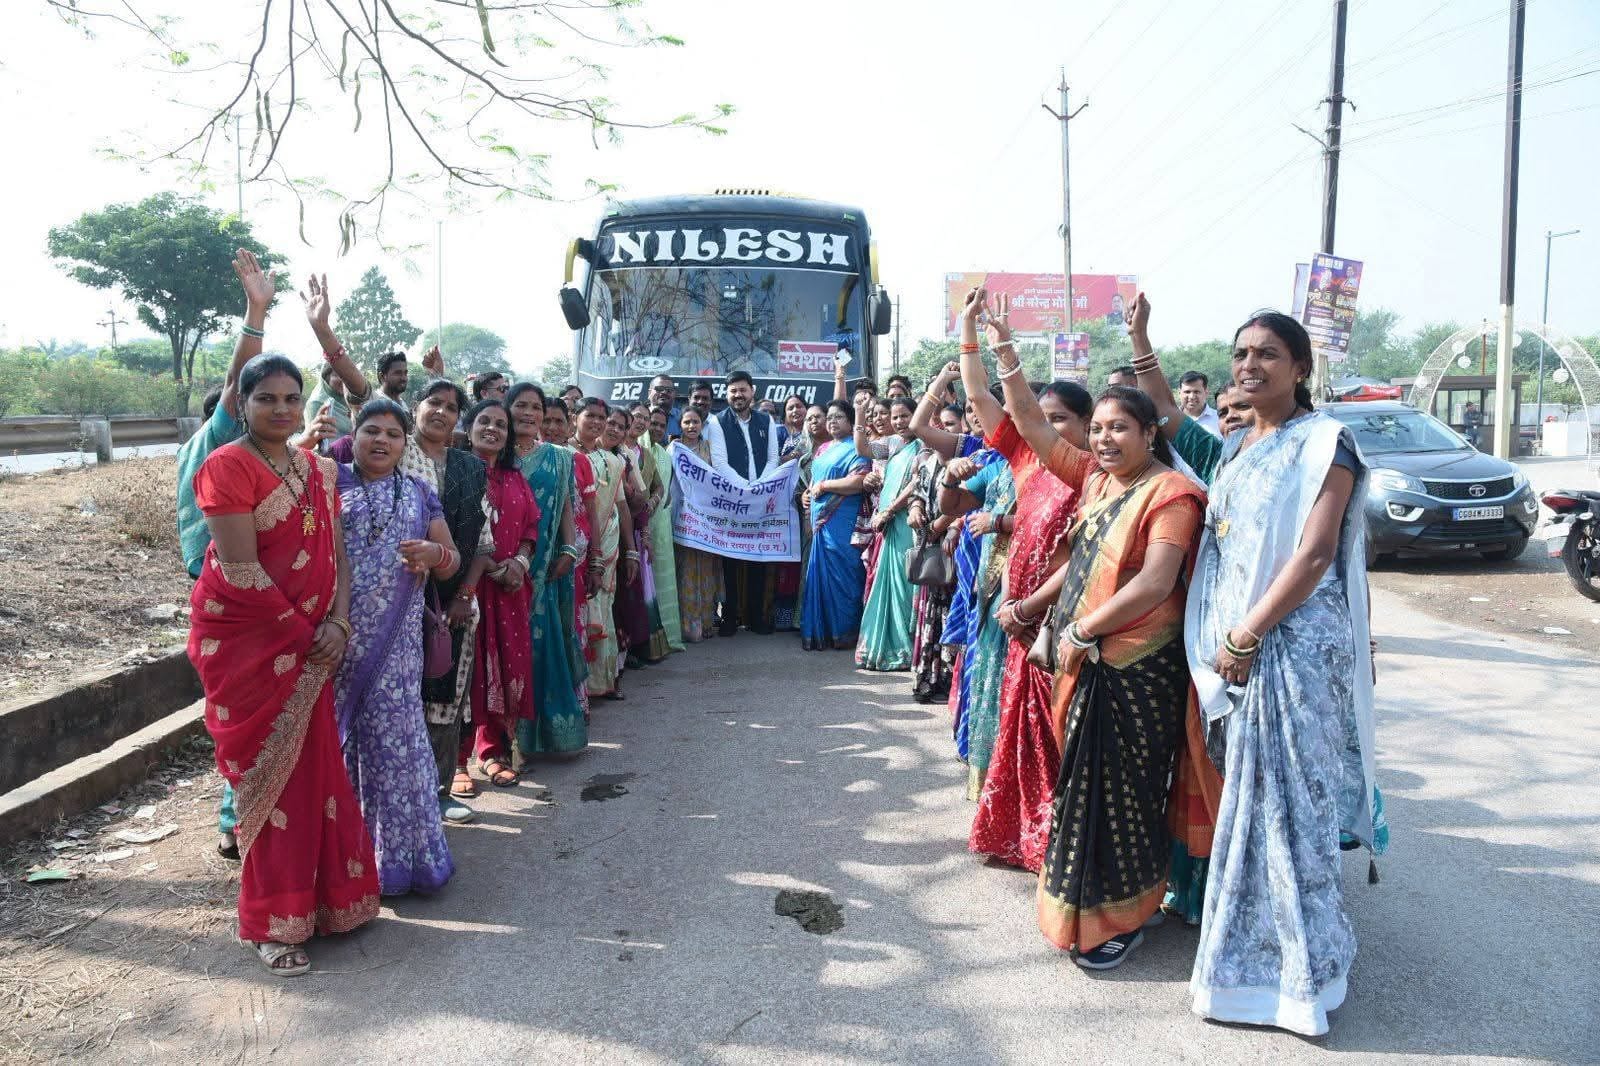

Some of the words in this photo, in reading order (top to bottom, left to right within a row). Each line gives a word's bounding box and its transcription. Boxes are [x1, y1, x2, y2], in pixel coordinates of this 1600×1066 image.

[608, 228, 849, 266] NILESH
[779, 344, 834, 371] स्पेशल
[610, 382, 643, 400] 2X2
[764, 384, 817, 405] COACH
[678, 453, 708, 483] दिशा
